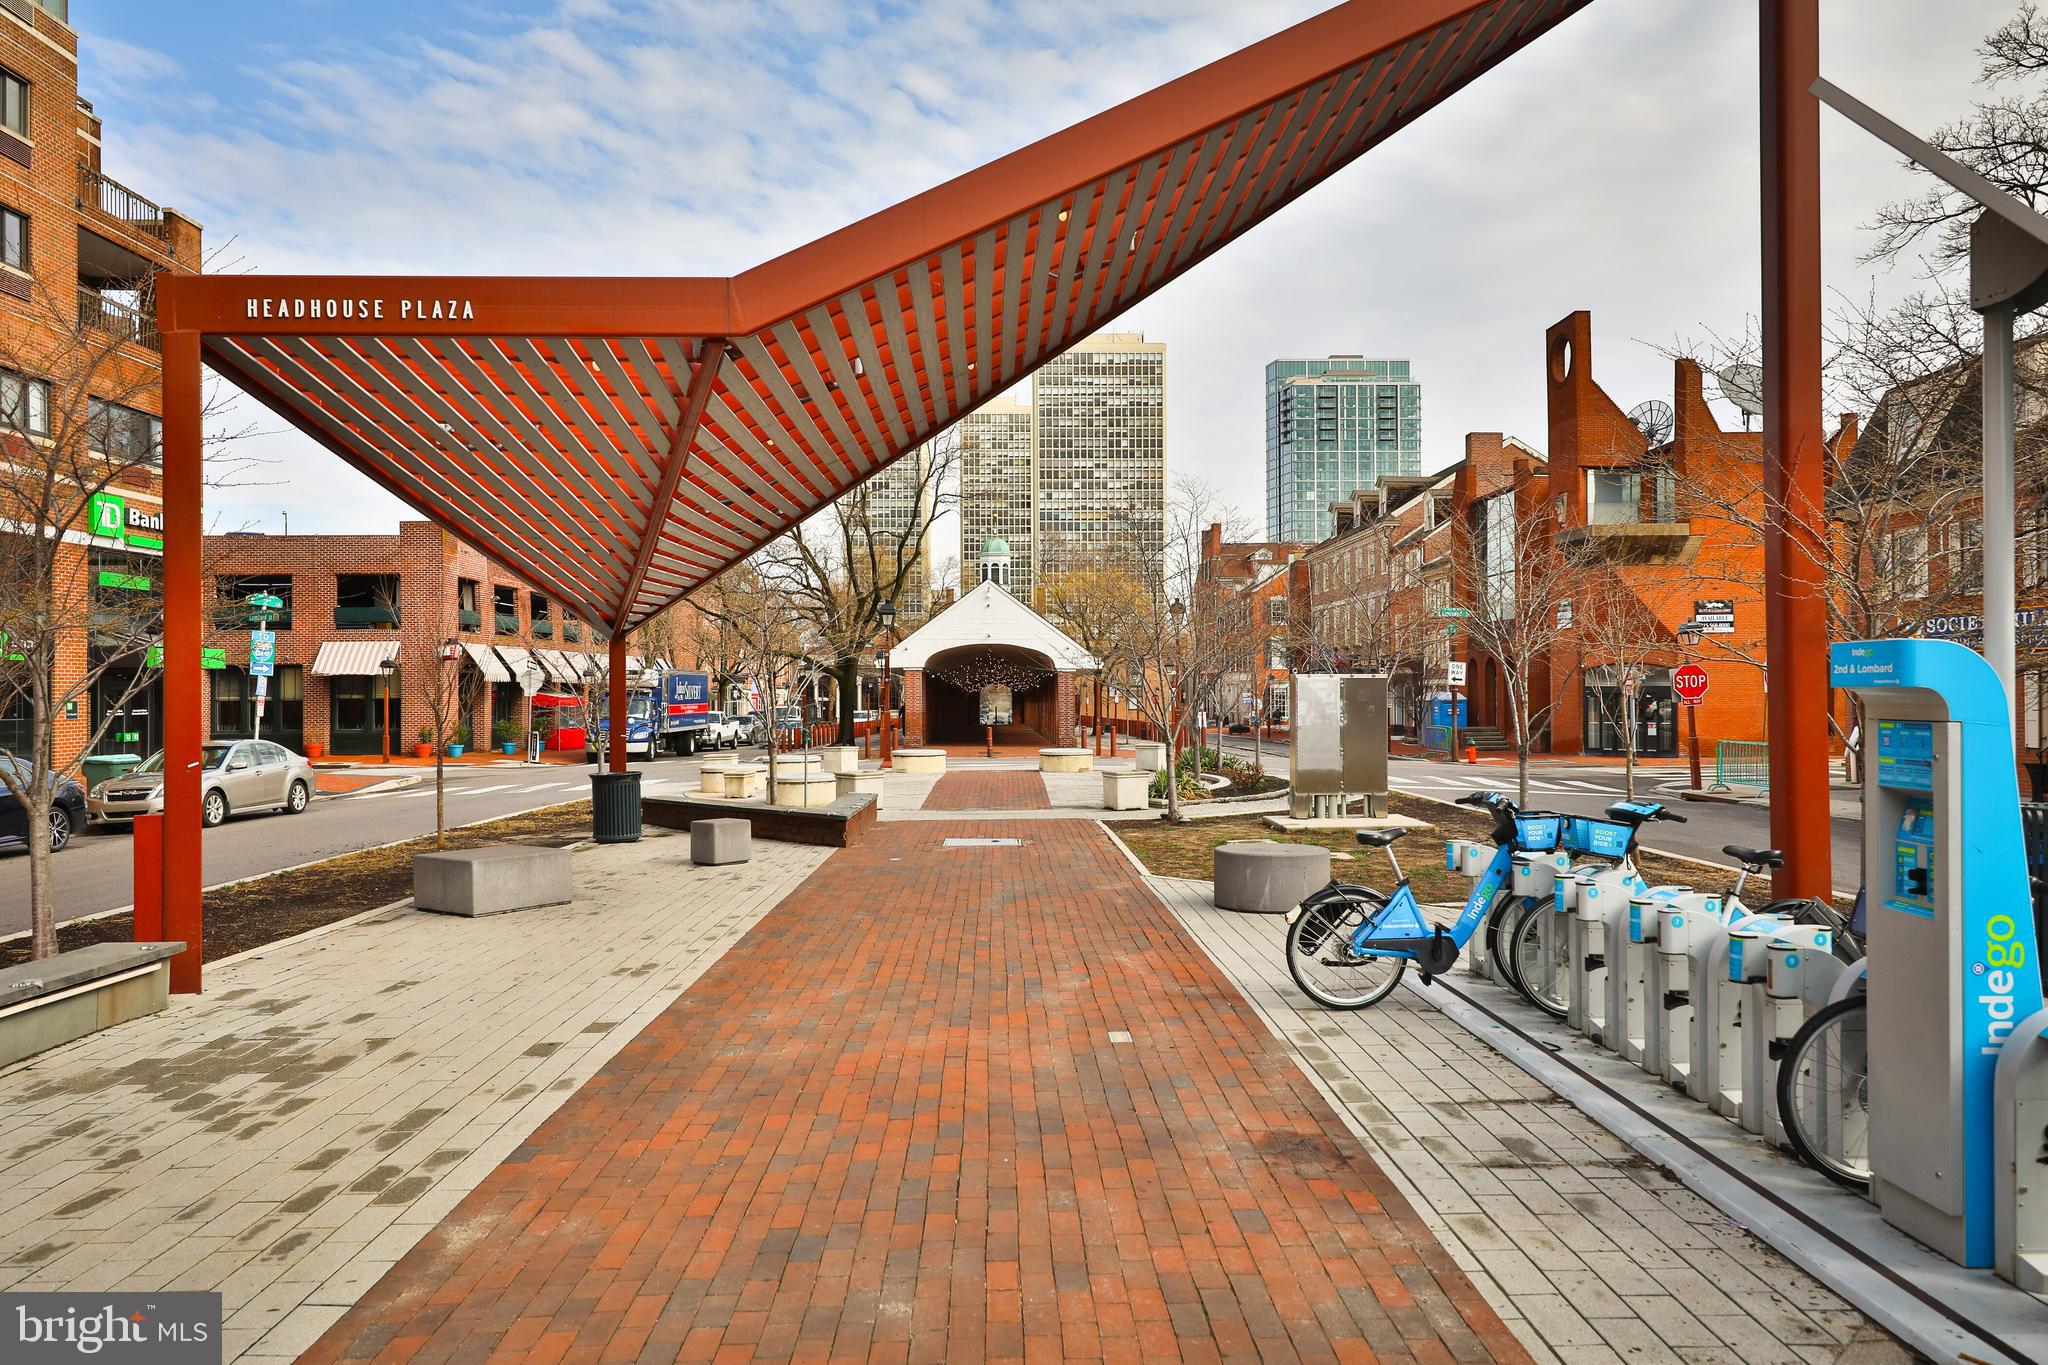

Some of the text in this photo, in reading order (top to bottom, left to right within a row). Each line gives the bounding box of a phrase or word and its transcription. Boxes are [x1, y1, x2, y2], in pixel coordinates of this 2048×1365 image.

[247, 299, 474, 319] HEADHOUSE PLAZA
[97, 501, 120, 528] TD
[1926, 615, 1984, 633] SOCIE
[1833, 663, 1893, 674] 2nd & Lombard
[1676, 675, 1706, 688] STOP
[1594, 829, 1617, 837] BOOST
[1467, 883, 1493, 920] Indego
[1978, 914, 2026, 1055] Indego
